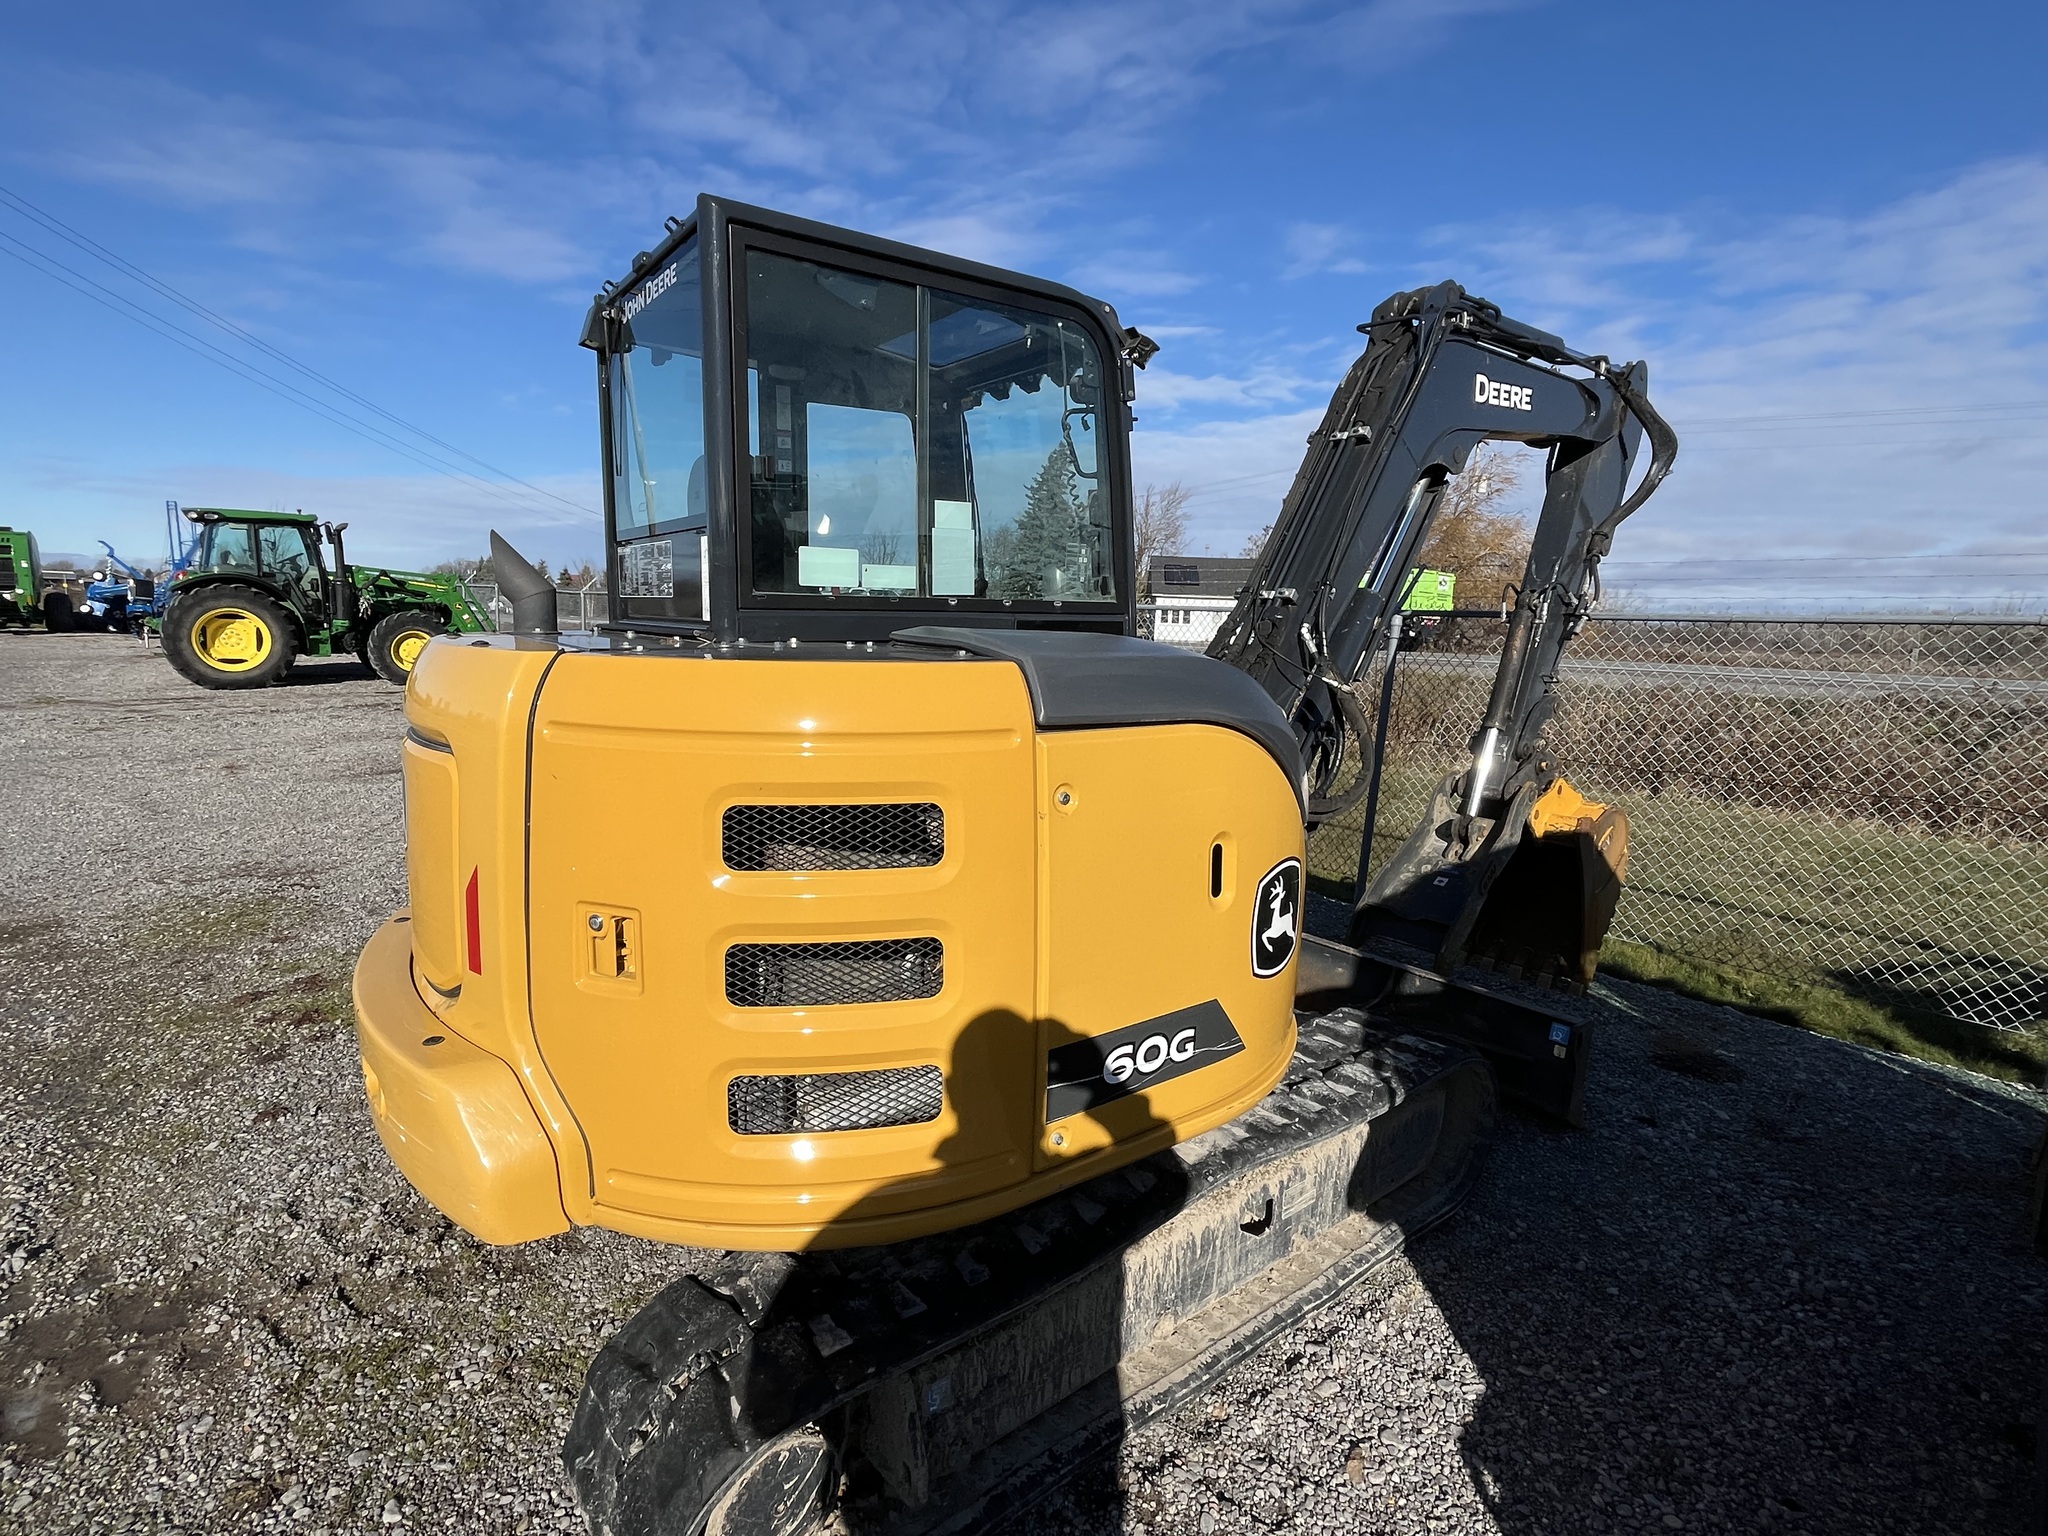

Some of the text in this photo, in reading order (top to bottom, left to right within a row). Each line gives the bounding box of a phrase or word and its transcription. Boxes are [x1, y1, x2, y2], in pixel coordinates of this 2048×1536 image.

[621, 262, 678, 324] JOHN DEERE
[1474, 373, 1533, 411] DEERE
[1102, 1027, 1197, 1085] 60G
